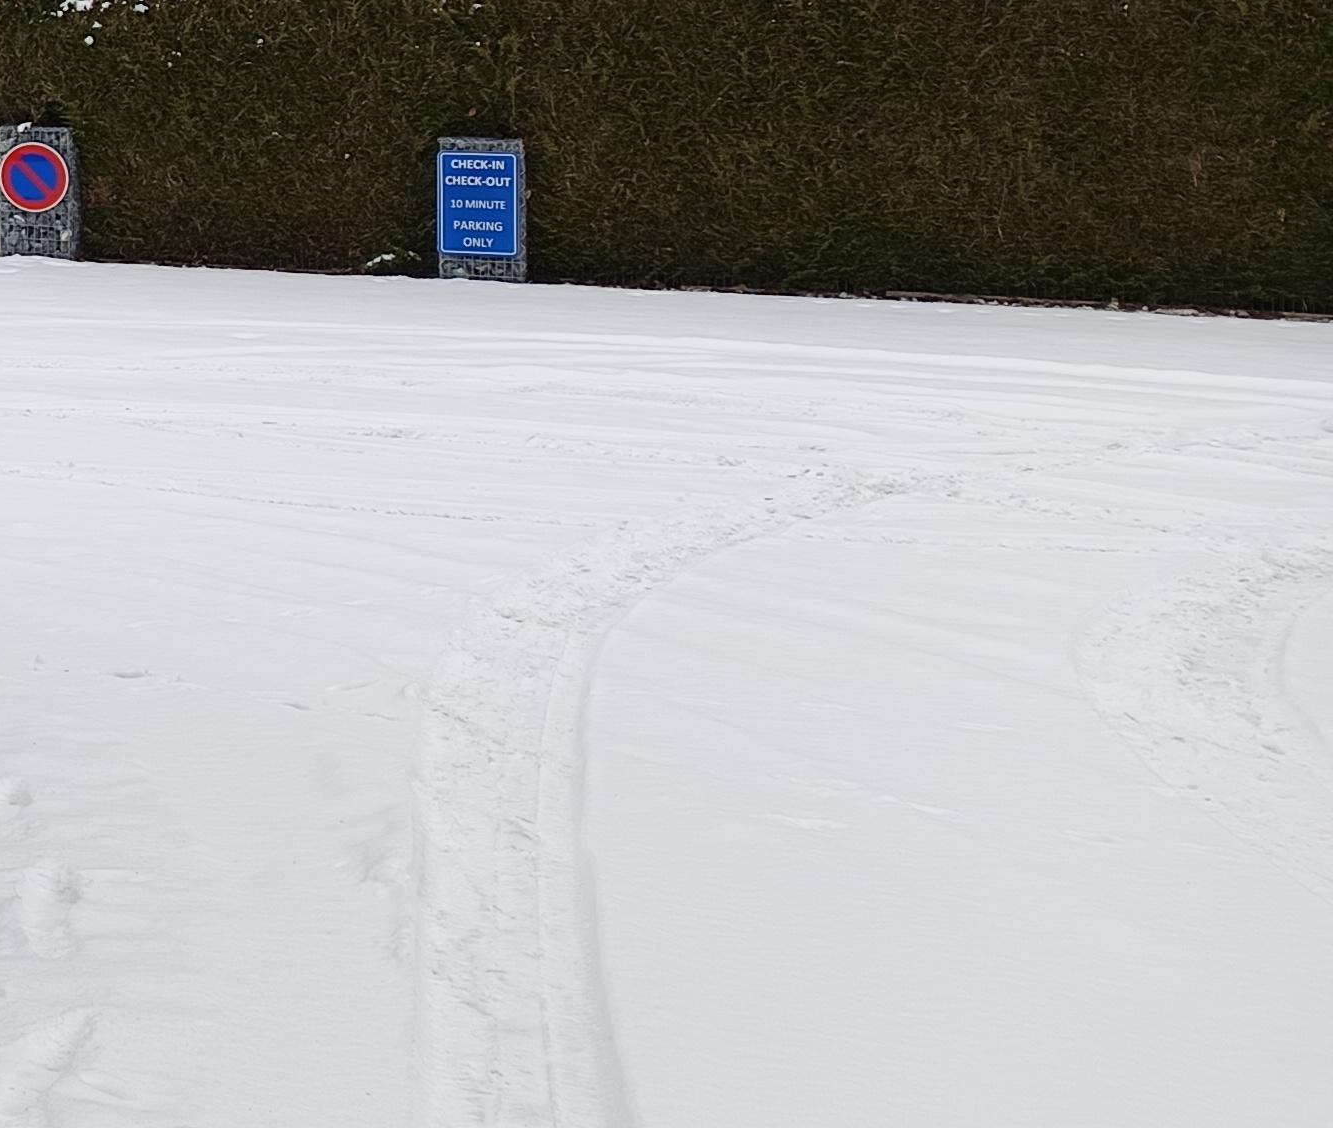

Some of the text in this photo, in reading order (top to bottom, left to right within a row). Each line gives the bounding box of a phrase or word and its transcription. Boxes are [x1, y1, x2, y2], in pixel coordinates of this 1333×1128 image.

[450, 158, 505, 170] CHECK-IN
[445, 175, 511, 187] CHECK-OUT
[450, 199, 506, 210] 10 MINUTE
[453, 220, 503, 231] PARKING
[463, 237, 494, 247] ONLY
